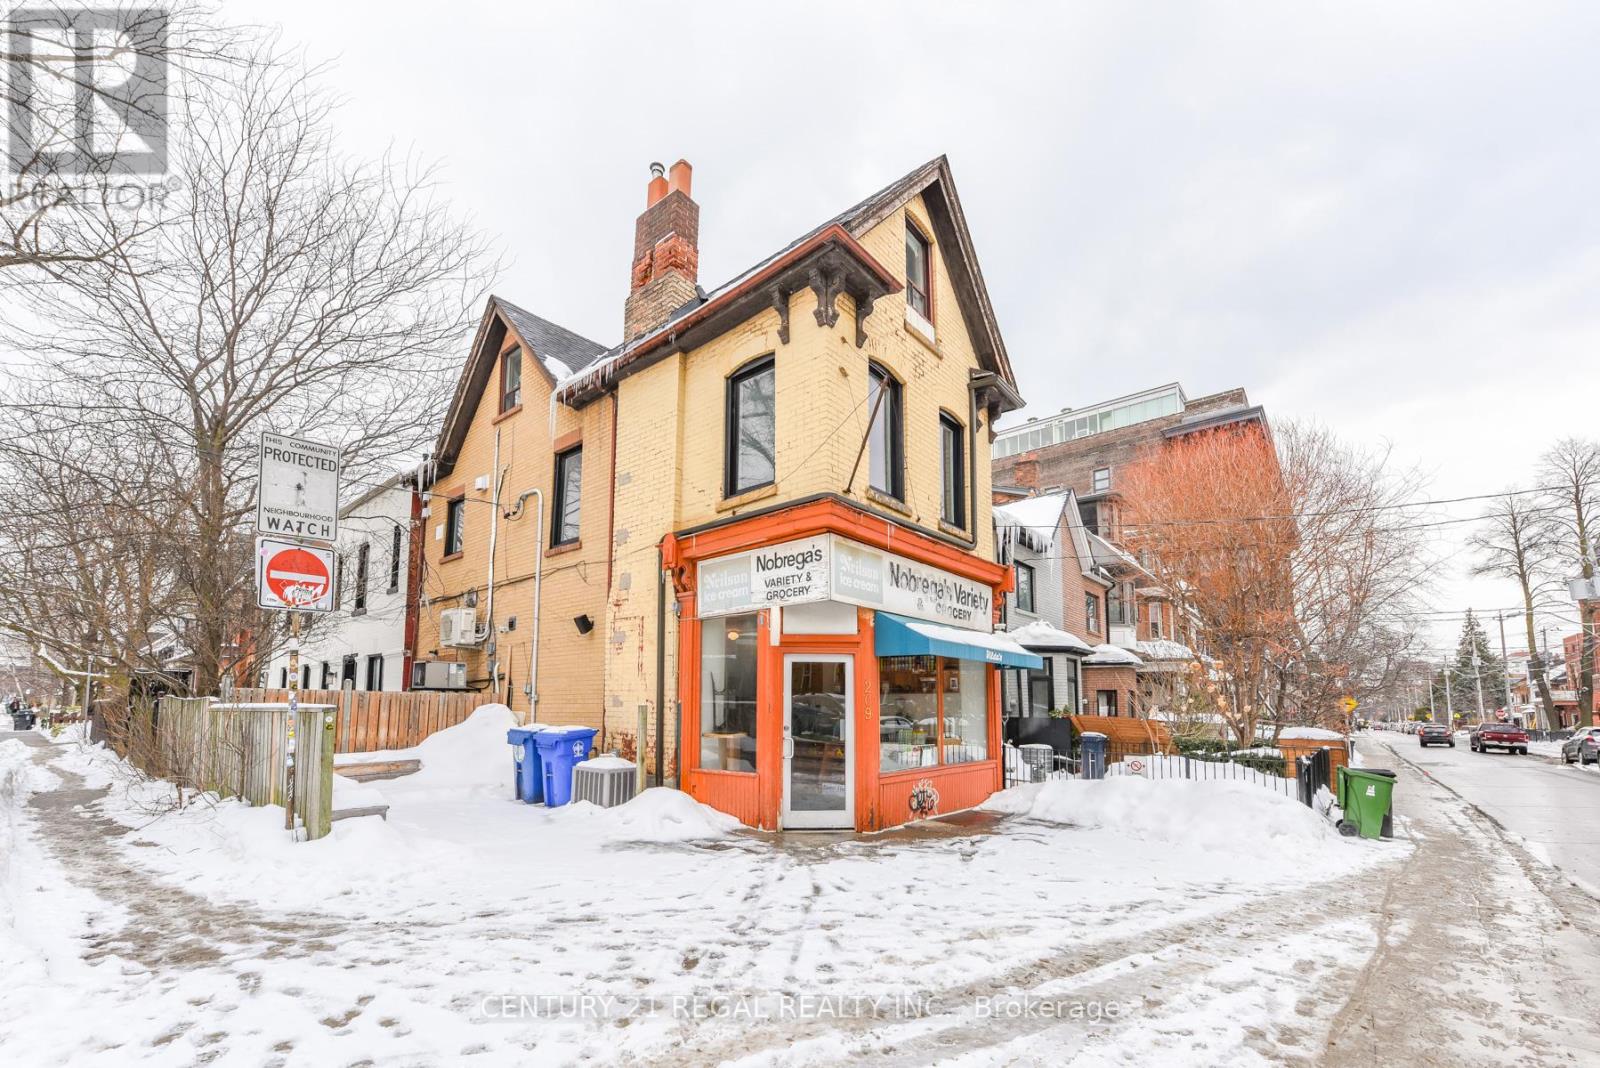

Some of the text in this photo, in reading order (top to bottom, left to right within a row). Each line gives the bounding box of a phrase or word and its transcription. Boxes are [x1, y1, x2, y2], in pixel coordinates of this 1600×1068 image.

[265, 436, 337, 457] THIS COMMUNITY
[264, 446, 337, 472] PROTECTED
[263, 506, 333, 523] NEIGHBOURHOOD
[267, 516, 330, 537] WATCH
[756, 544, 823, 573] Nobrega's
[764, 571, 812, 588] VARIETY &
[766, 586, 811, 601] GROCERY
[953, 581, 989, 616] Variety
